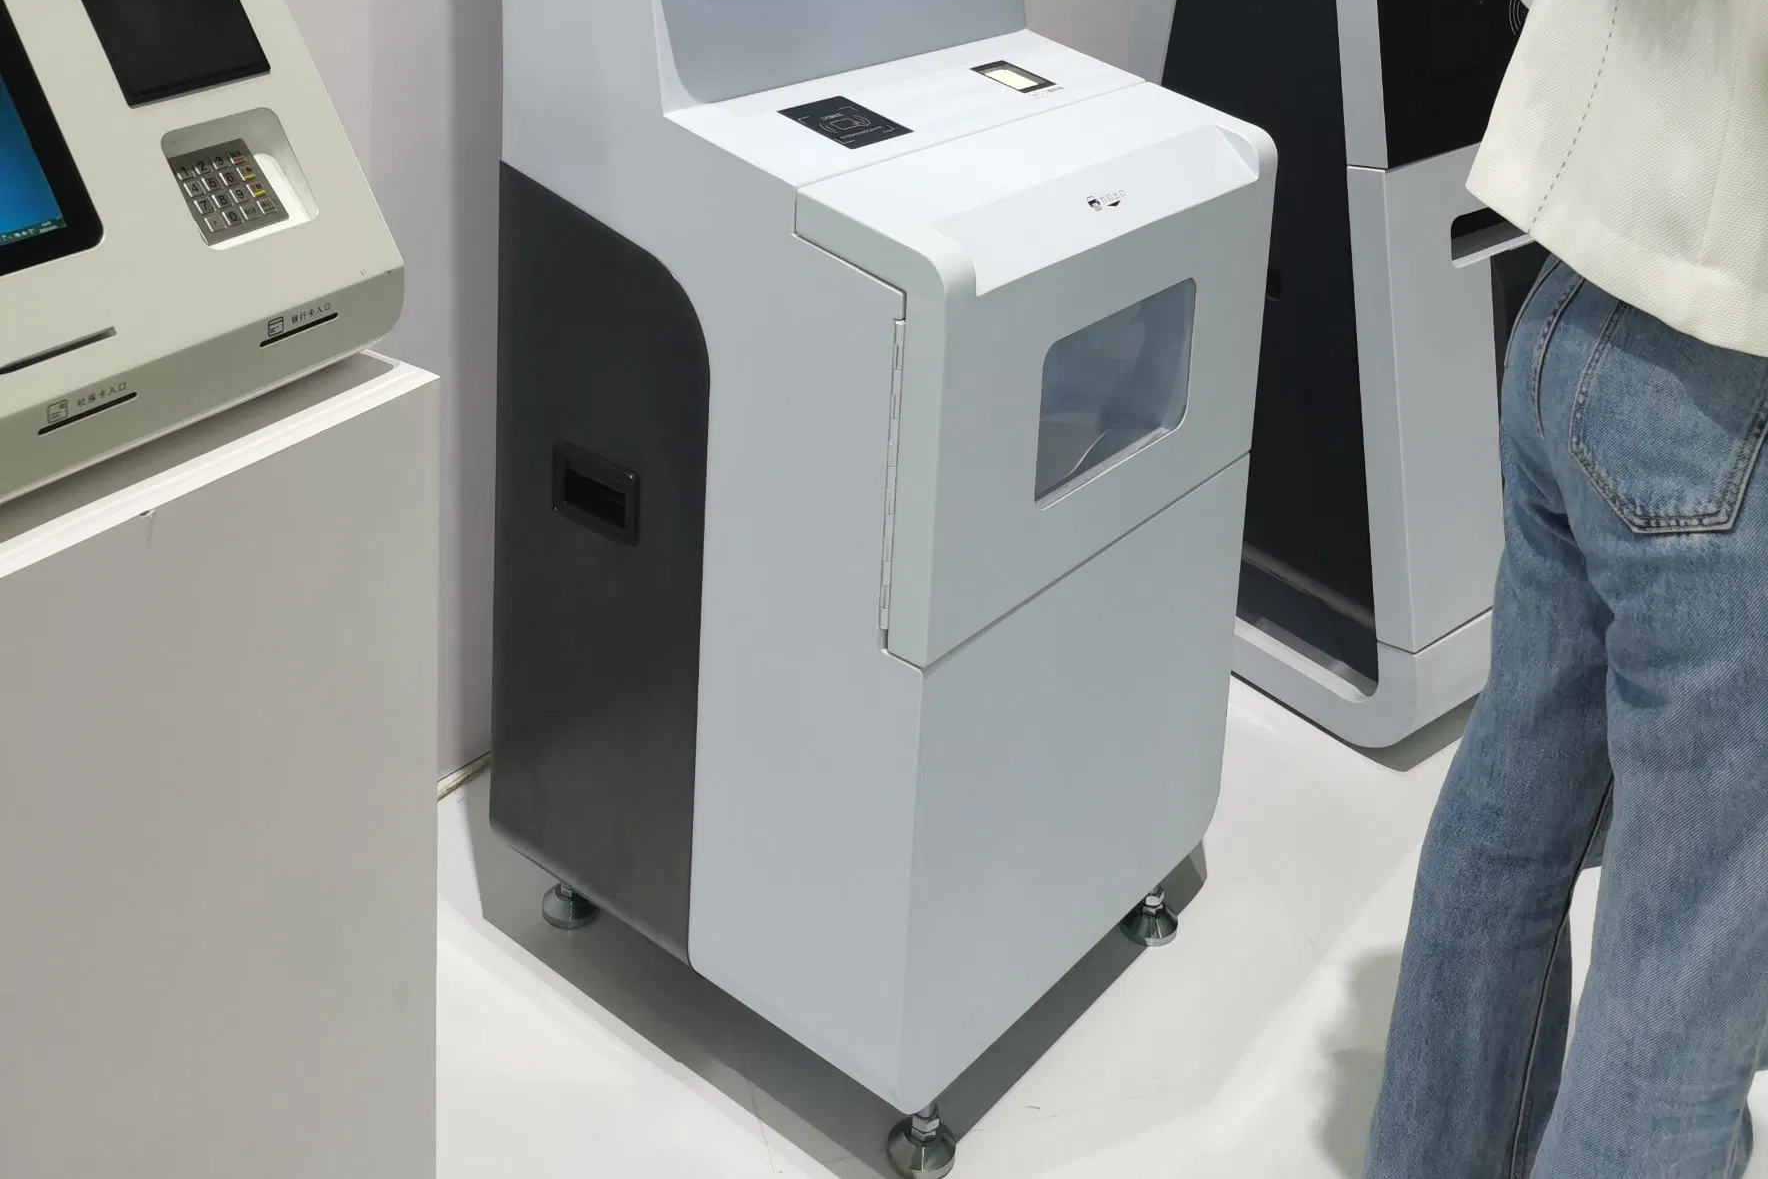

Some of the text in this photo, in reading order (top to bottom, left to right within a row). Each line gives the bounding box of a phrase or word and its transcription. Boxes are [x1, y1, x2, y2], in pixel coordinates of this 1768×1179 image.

[199, 161, 207, 171] 2
[217, 156, 224, 165] 3
[191, 172, 235, 193] 4 5 6
[200, 189, 244, 211] 7 8 9
[228, 212, 238, 222] 0
